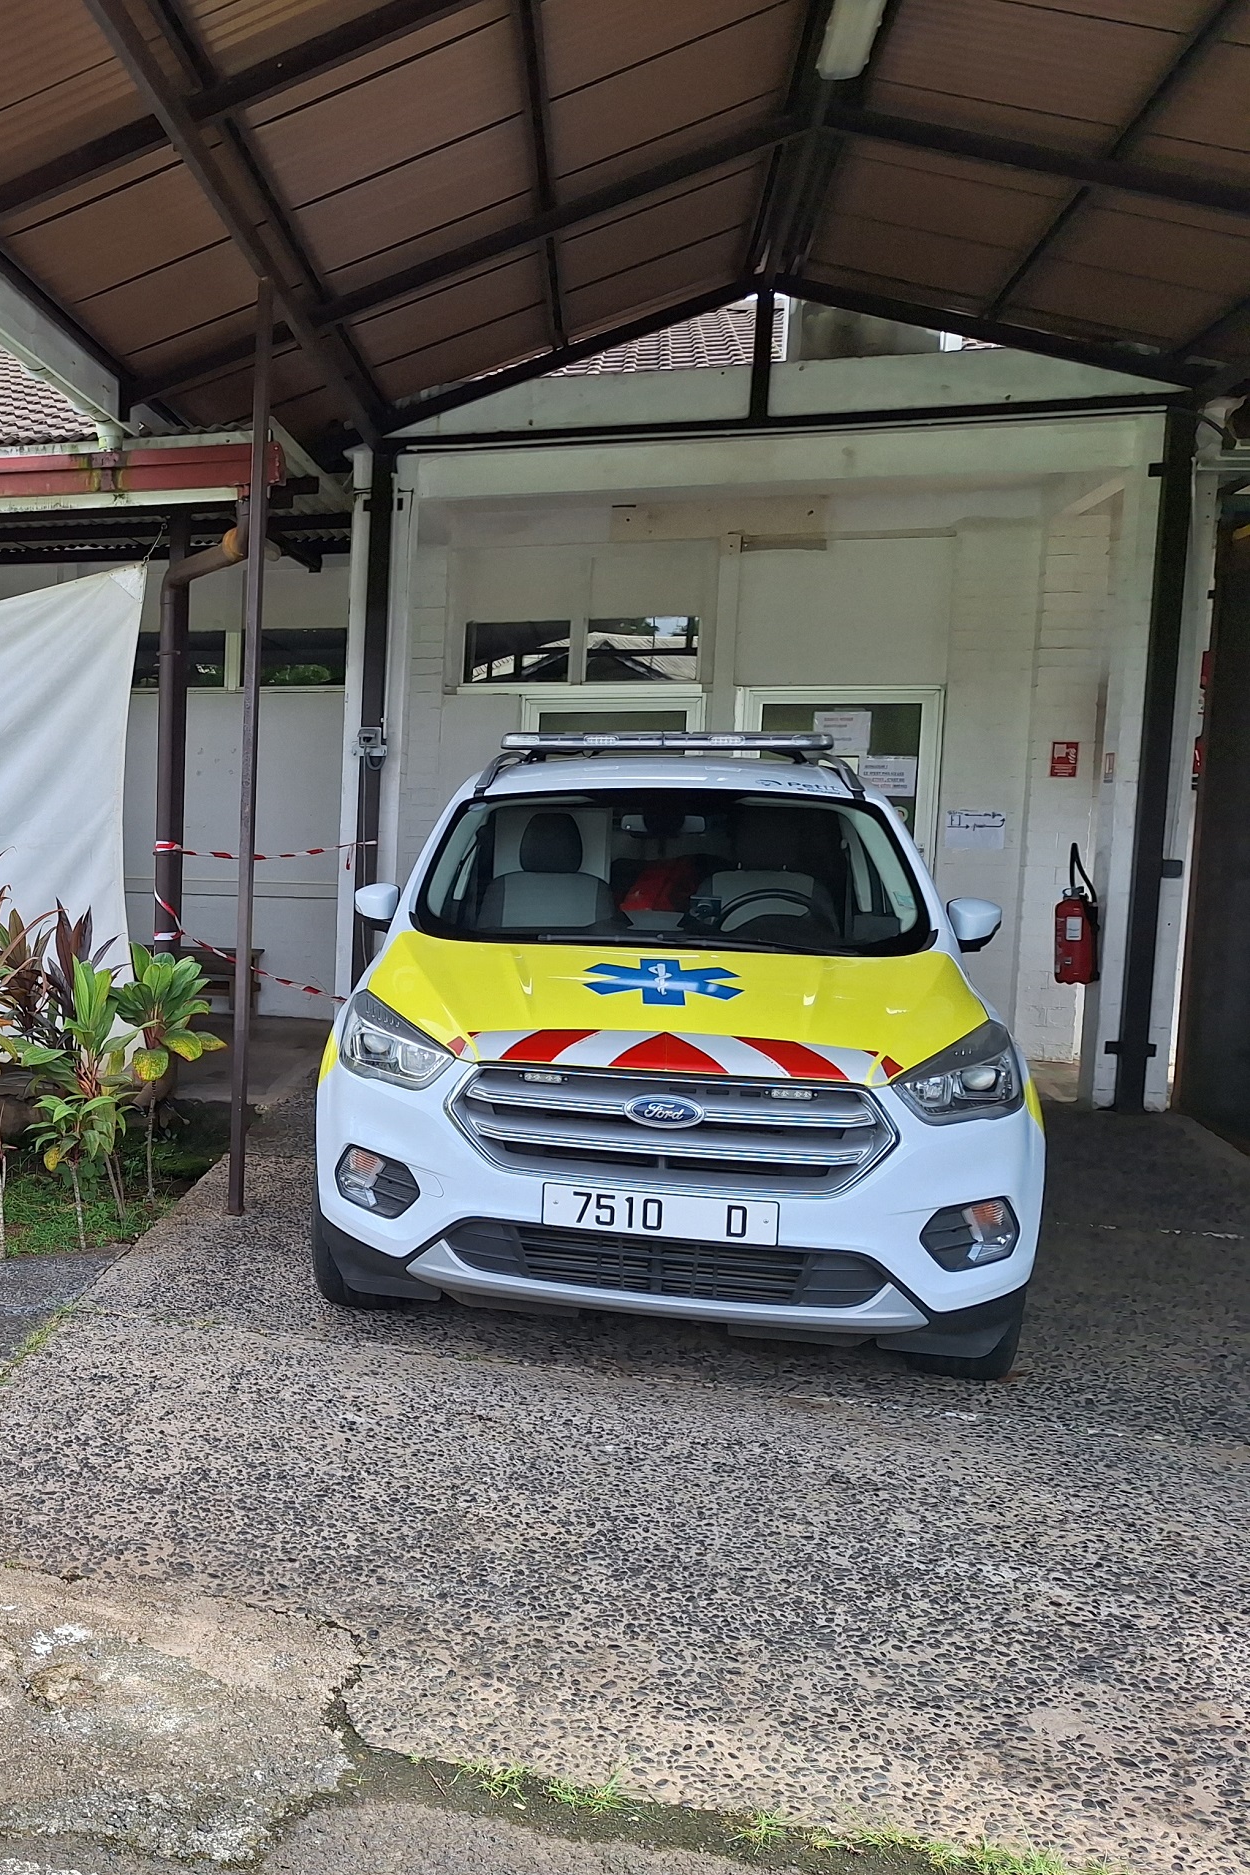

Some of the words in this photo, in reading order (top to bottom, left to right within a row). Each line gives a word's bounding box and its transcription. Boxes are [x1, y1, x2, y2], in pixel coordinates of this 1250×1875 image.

[643, 1102, 684, 1120] Ford
[572, 1190, 663, 1231] 7510
[725, 1204, 748, 1238] D
